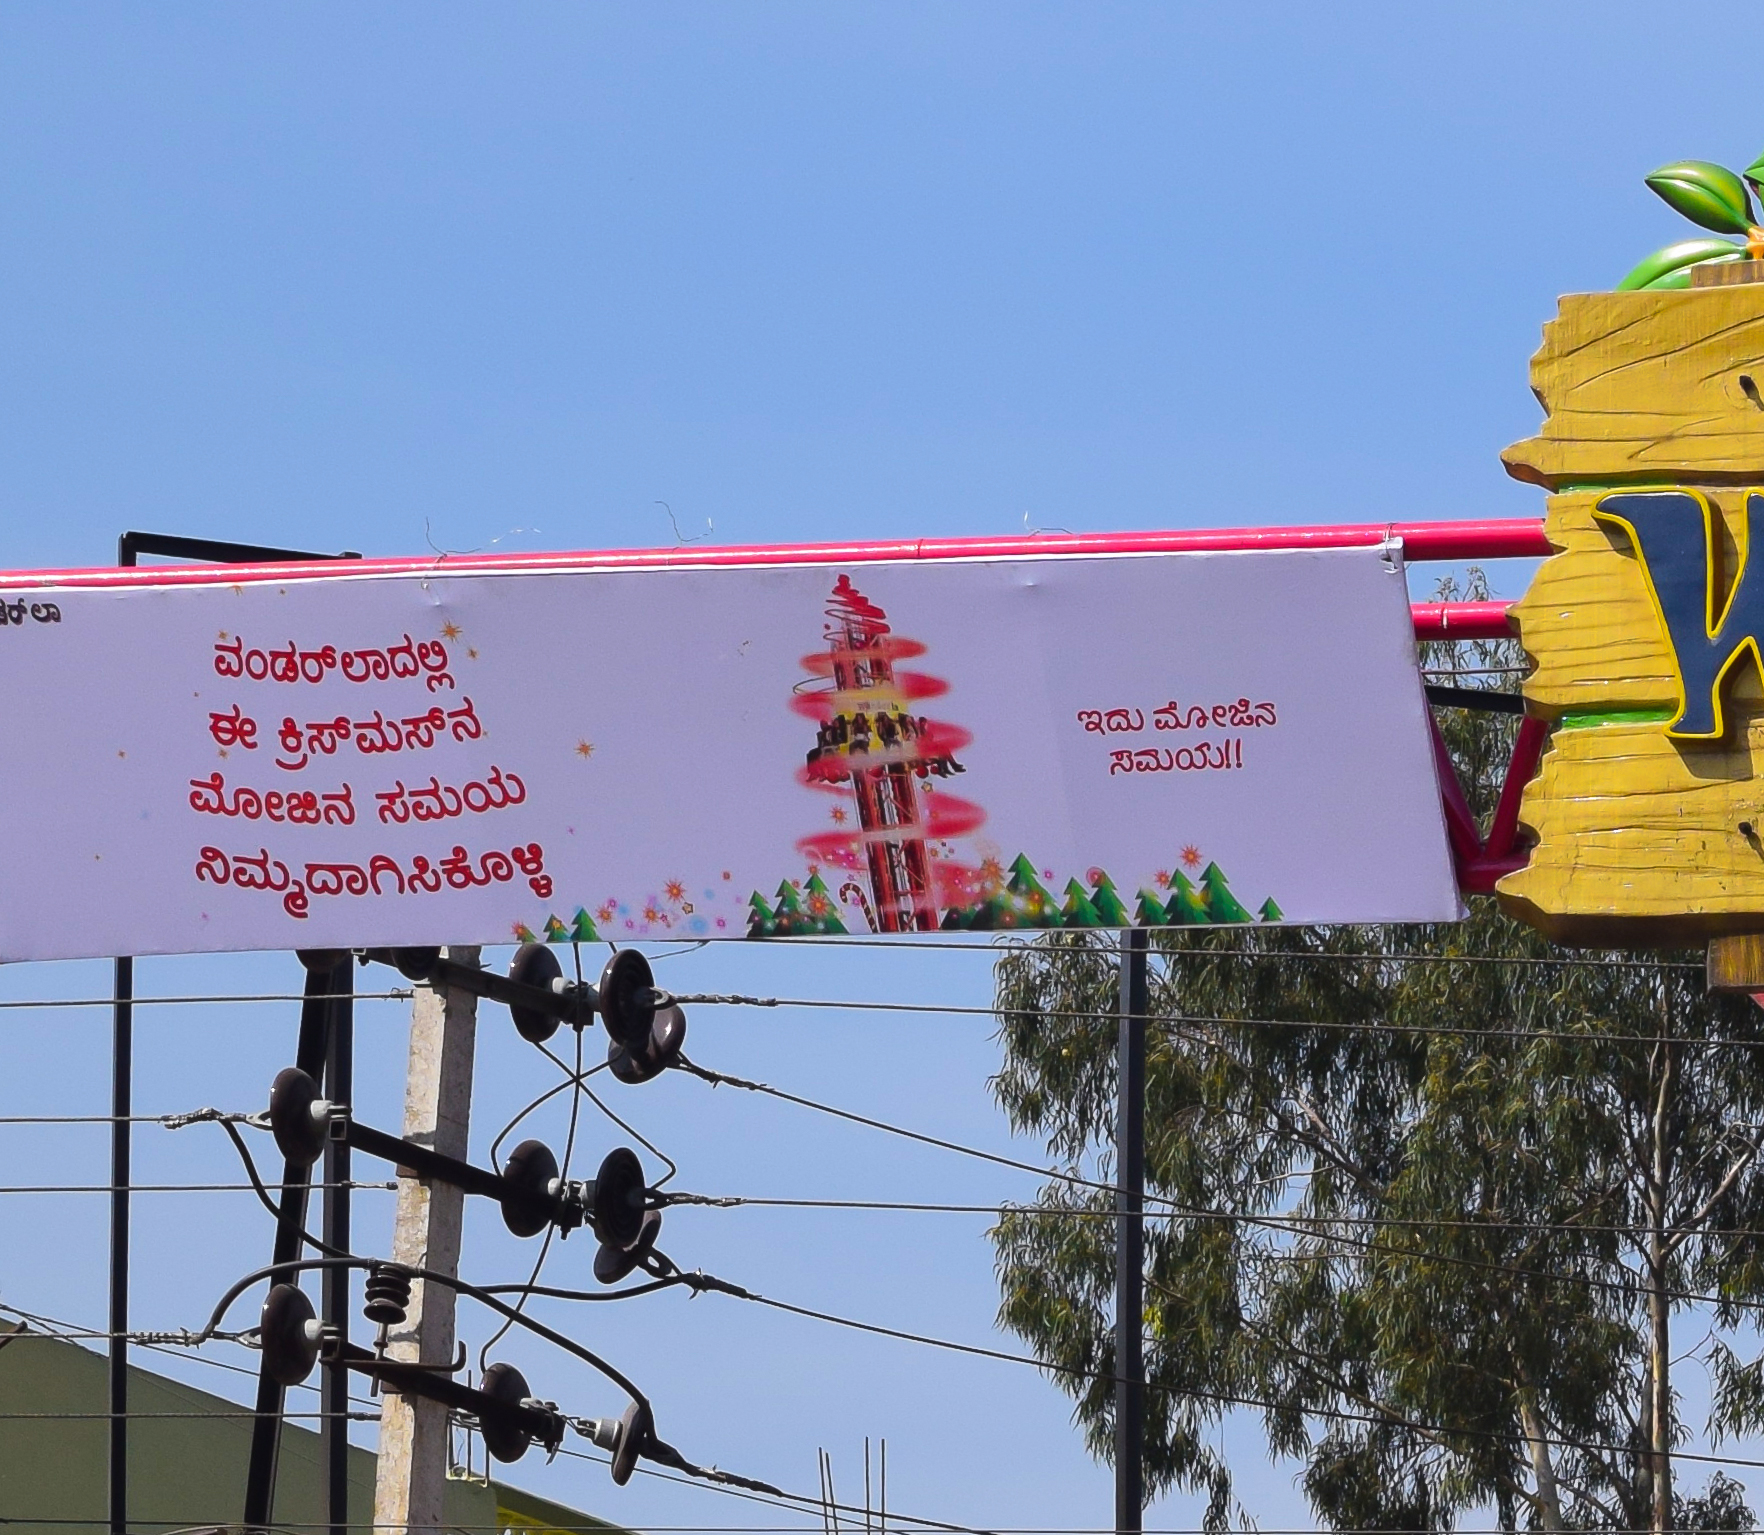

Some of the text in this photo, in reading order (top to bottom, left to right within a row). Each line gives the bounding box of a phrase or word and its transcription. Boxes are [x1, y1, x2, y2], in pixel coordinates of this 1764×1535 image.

[208, 703, 259, 749] ಈ
[1077, 708, 1145, 736] ಇದು
[374, 765, 526, 824] ಸಮಯ
